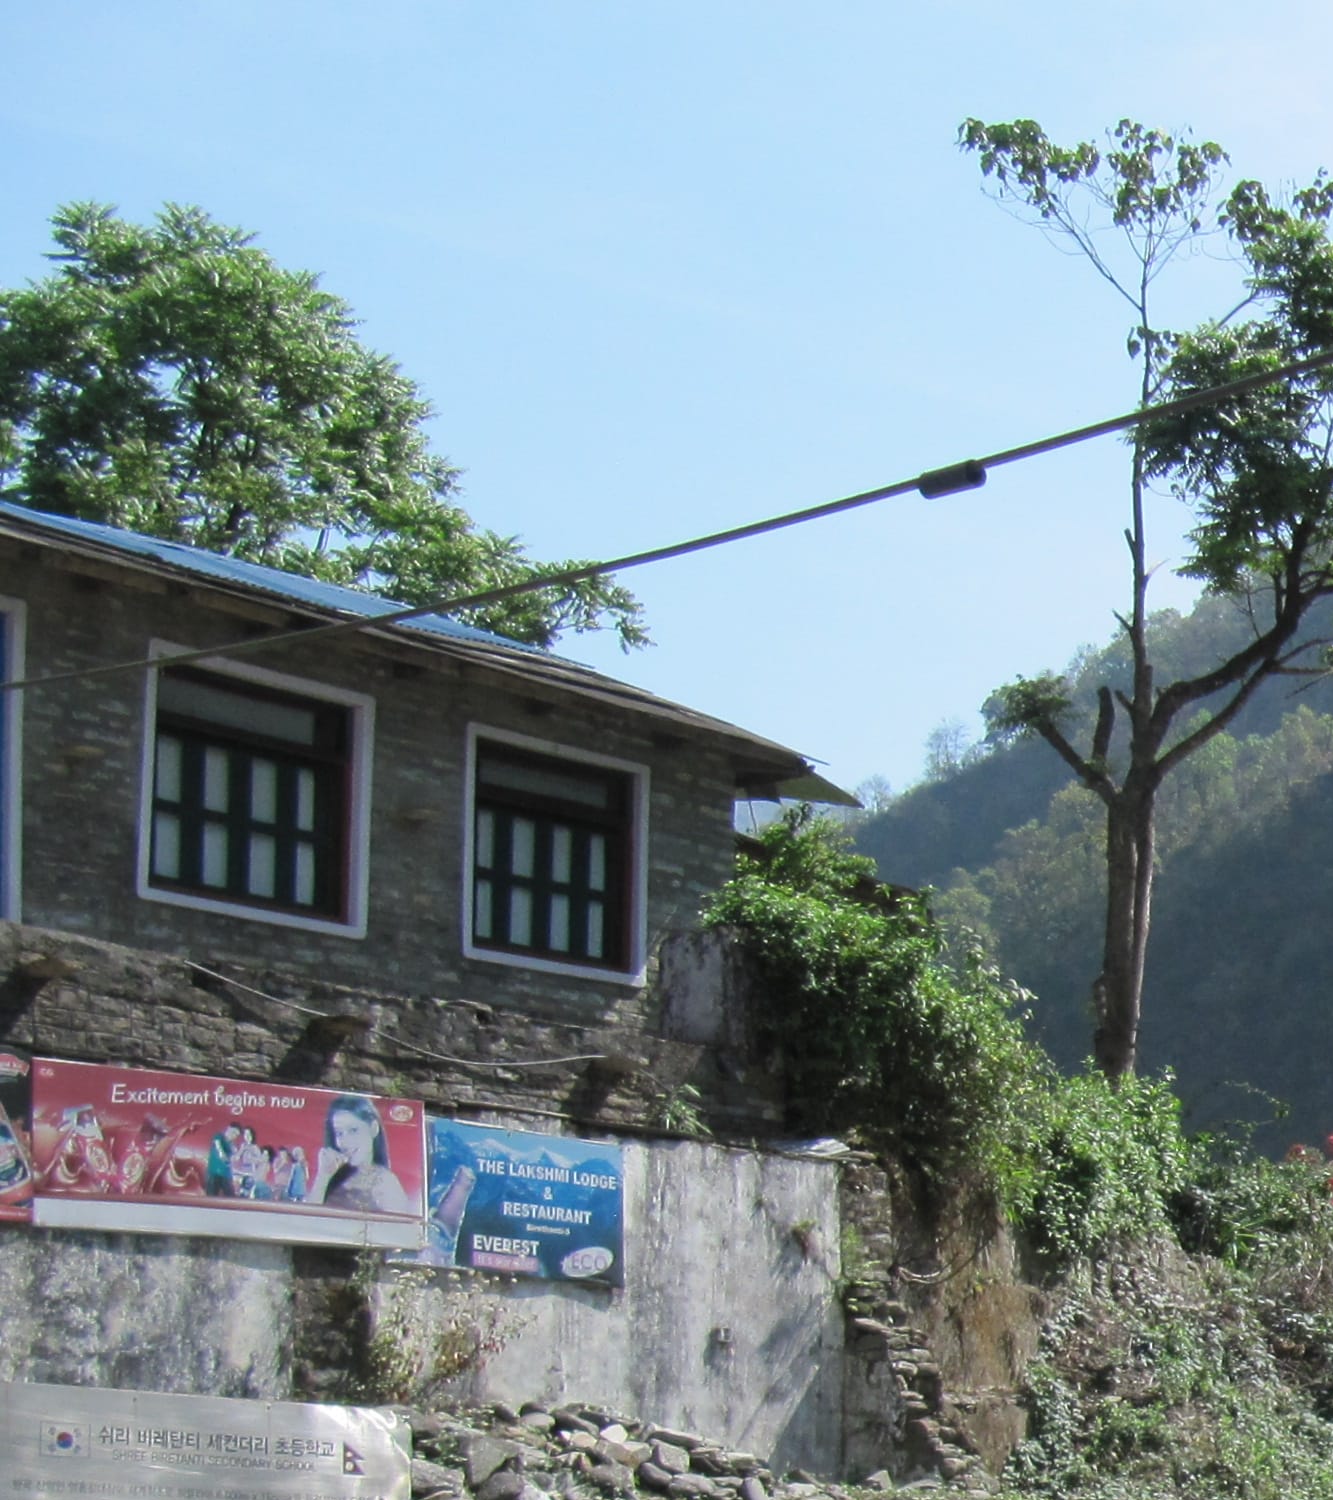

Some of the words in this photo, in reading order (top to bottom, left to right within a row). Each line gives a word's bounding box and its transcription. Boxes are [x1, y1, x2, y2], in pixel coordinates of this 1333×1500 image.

[110, 1083, 209, 1105] Excitement
[214, 1085, 266, 1115] begins
[270, 1096, 306, 1109] now
[477, 1158, 506, 1175] THE
[509, 1163, 570, 1183] LAKSHMI
[573, 1171, 618, 1190] LODGE
[543, 1187, 554, 1200] &
[502, 1201, 593, 1225] RESTAURANT
[472, 1234, 541, 1257] EVEREST
[99, 1425, 130, 1446] 쉬리
[206, 1433, 269, 1456] 세컨더리
[274, 1437, 335, 1459] 초등학교
[112, 1448, 147, 1462] SHREE
